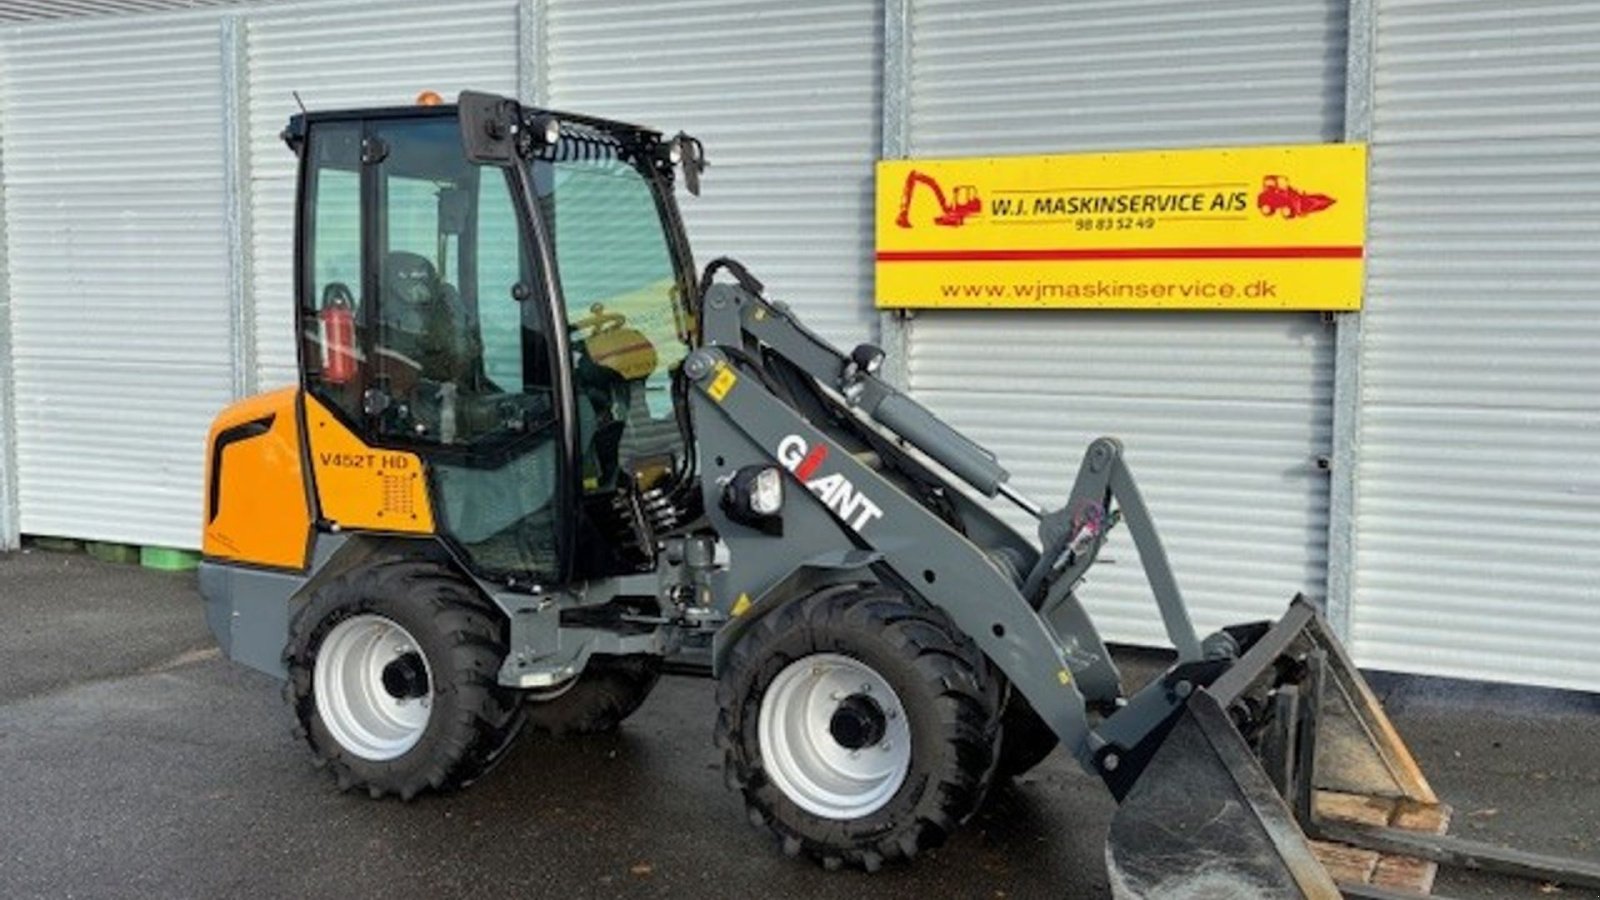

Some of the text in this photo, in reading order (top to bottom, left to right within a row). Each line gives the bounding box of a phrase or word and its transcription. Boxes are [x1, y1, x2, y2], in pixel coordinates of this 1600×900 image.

[1032, 193, 1205, 216] MASKINSERVICE
[1209, 192, 1248, 211] A/S
[1116, 217, 1133, 230] 52
[940, 280, 1277, 300] www.wjmaskinservice.dk
[319, 452, 409, 469] V452T HD
[777, 434, 884, 532] GIANT
